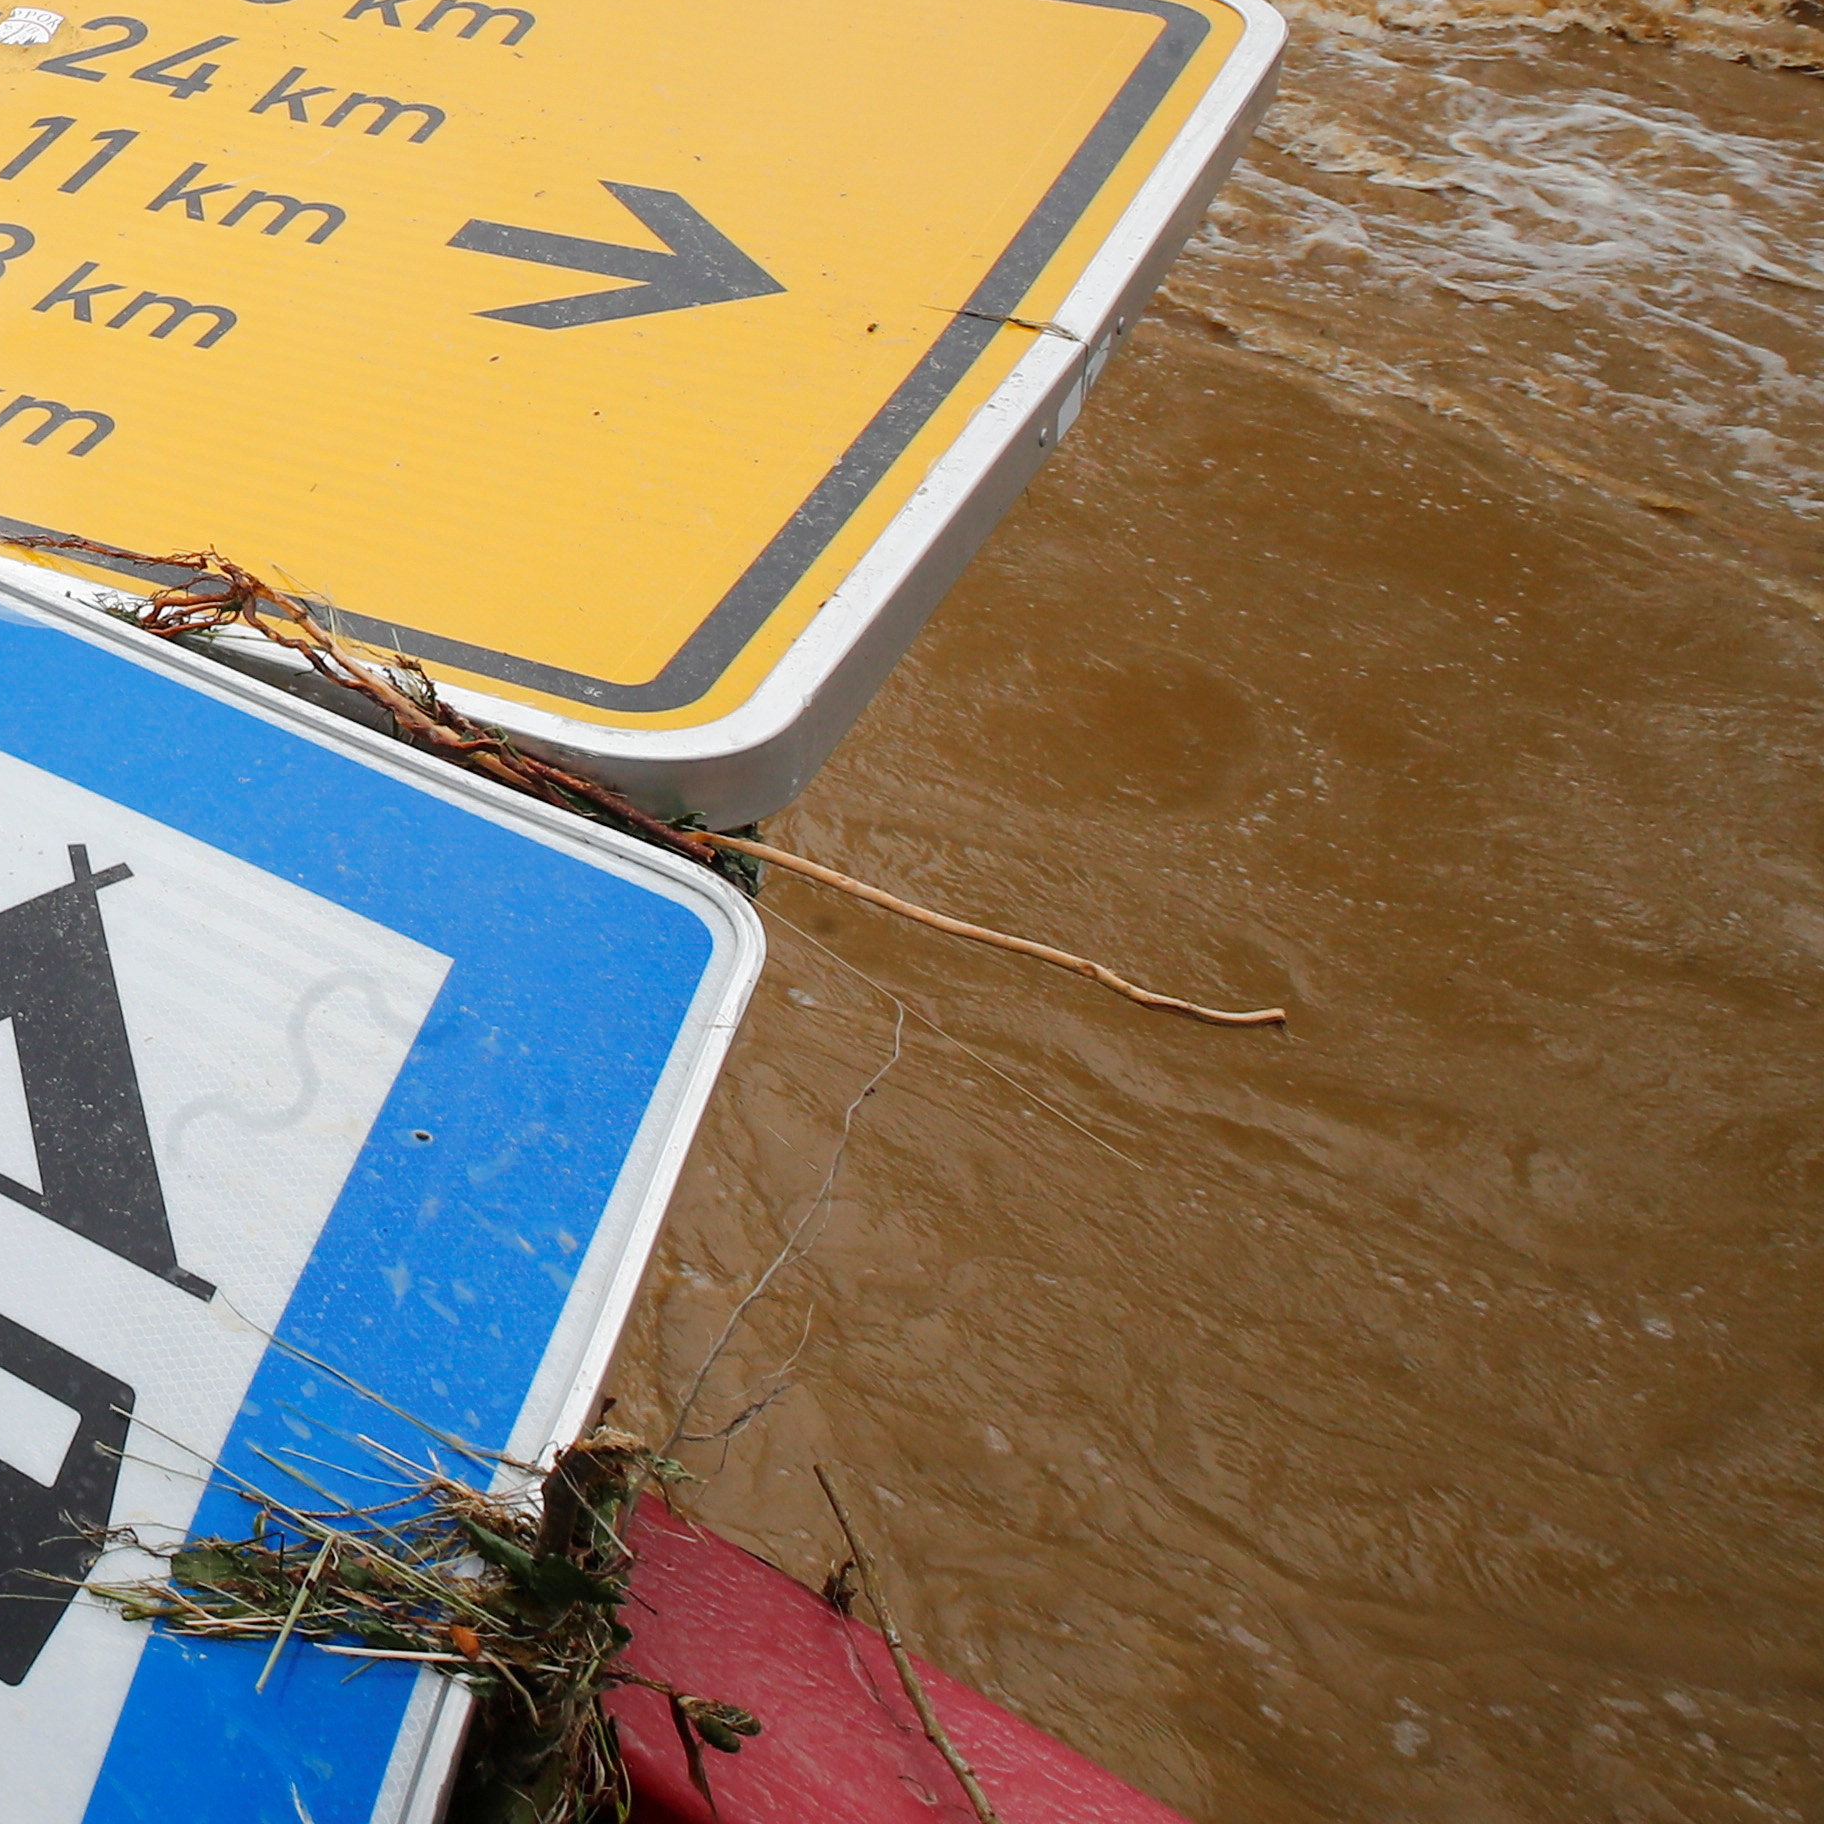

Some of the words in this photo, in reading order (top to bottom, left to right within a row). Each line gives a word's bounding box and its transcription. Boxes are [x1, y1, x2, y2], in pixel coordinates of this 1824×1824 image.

[36, 16, 237, 100] 24
[252, 66, 446, 144] km
[148, 162, 346, 245] km
[35, 261, 238, 349] km
